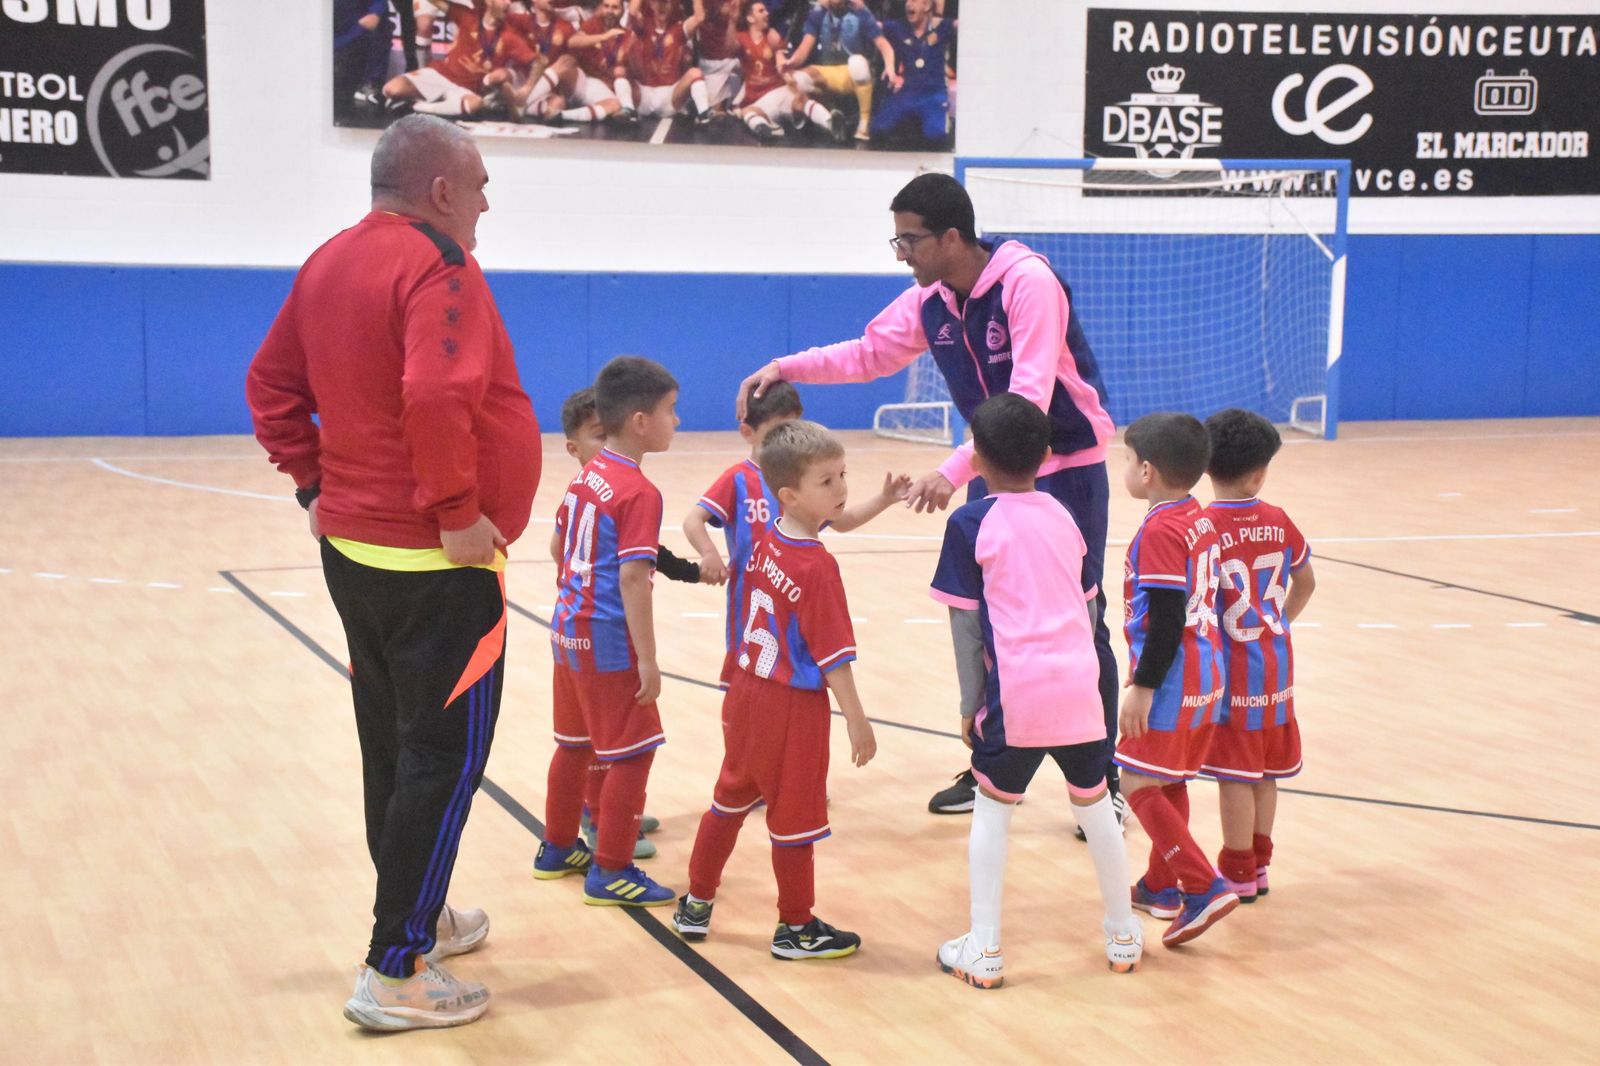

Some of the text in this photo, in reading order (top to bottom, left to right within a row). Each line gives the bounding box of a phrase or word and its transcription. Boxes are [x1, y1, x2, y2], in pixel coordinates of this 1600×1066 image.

[1103, 106, 1223, 144] DBASE
[1416, 131, 1589, 160] EL MARCADOR
[583, 470, 614, 502] PUERTO
[744, 498, 771, 524] 36
[1239, 525, 1285, 544] PUERTO
[1220, 551, 1287, 642] 23
[738, 588, 779, 679] 5
[1231, 694, 1268, 708] MUCHO
